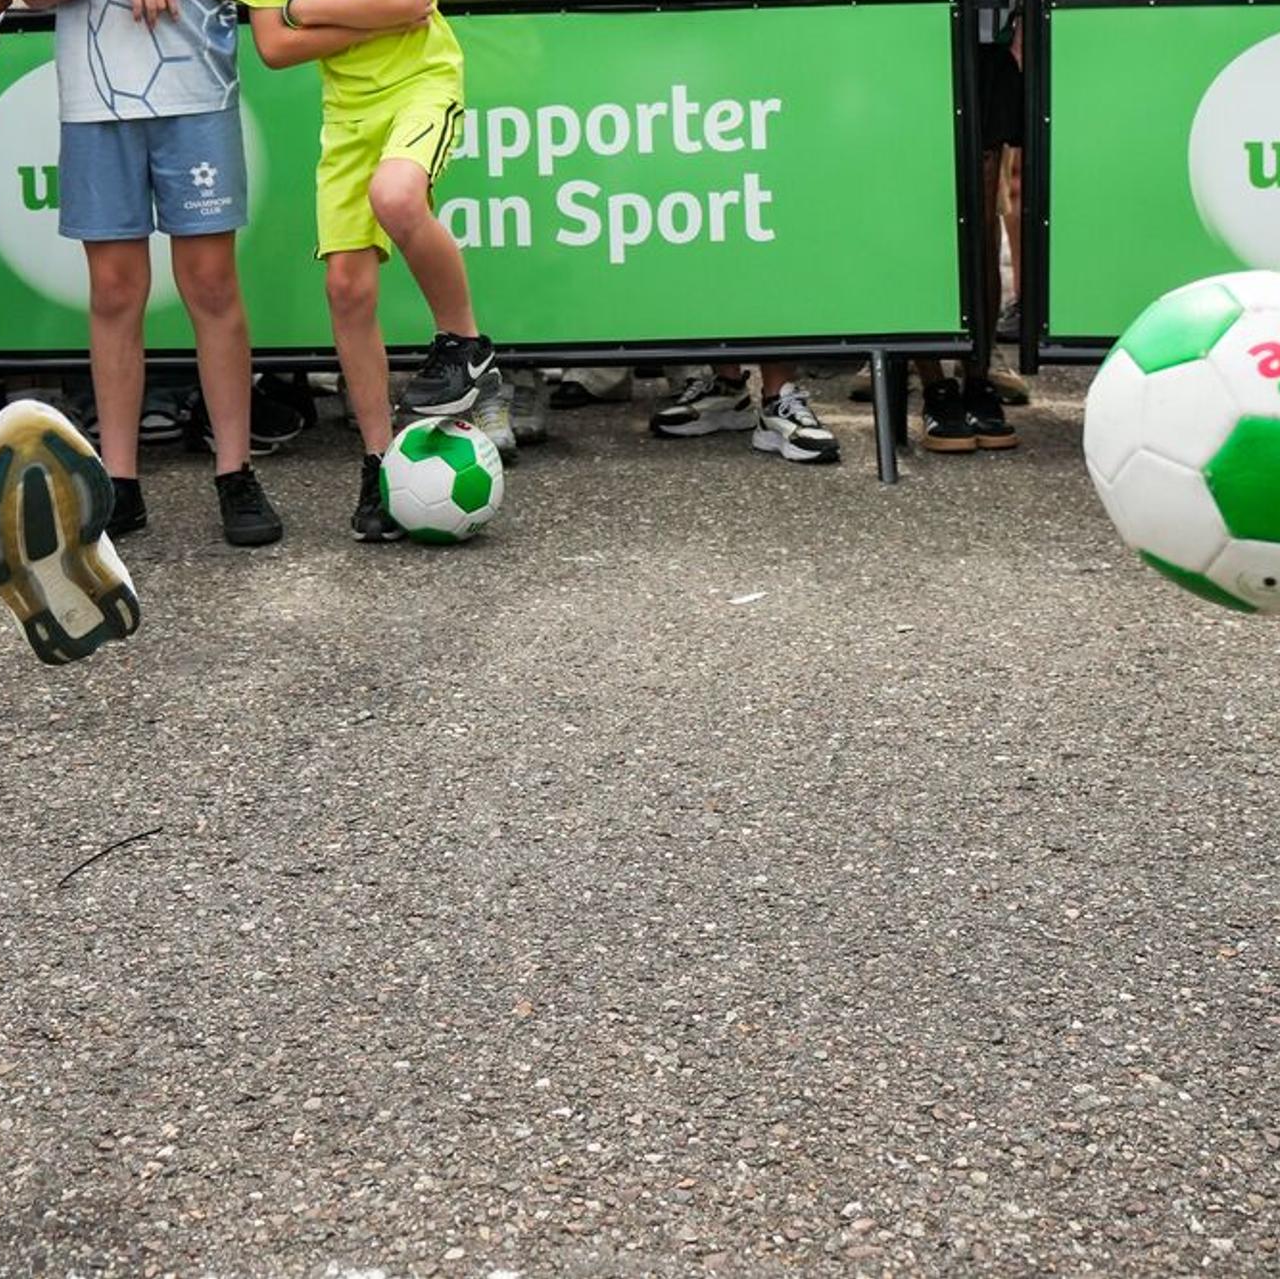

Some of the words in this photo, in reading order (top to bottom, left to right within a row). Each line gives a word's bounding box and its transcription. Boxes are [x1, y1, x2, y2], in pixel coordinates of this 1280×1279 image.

[448, 80, 782, 178] upporter
[438, 195, 533, 251] an
[555, 173, 776, 265] Sport
